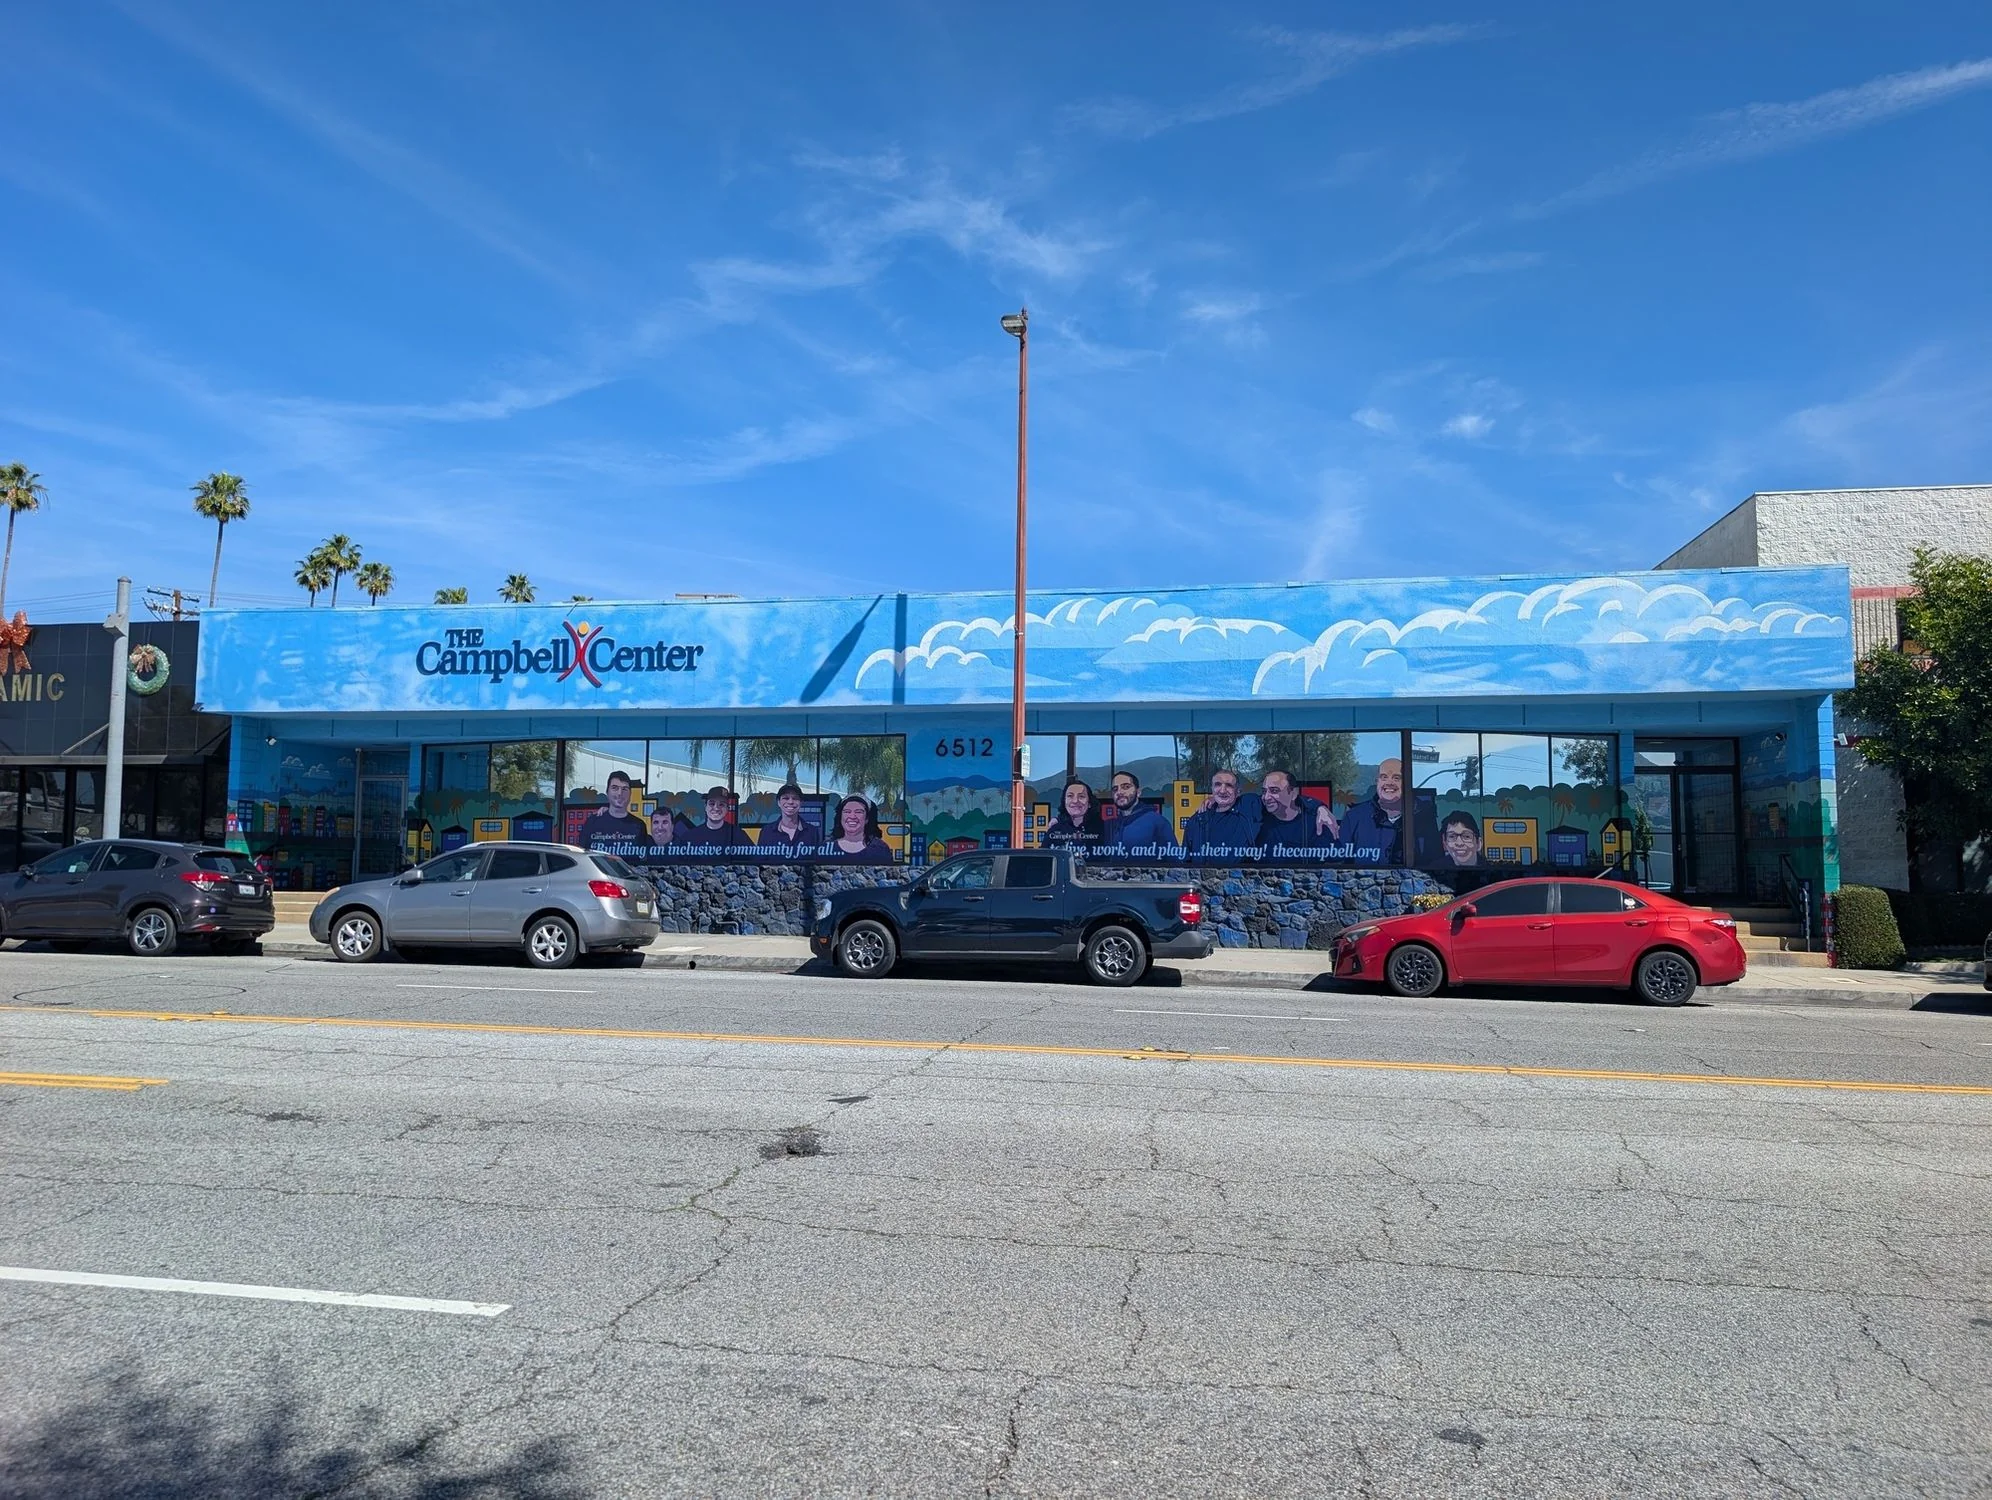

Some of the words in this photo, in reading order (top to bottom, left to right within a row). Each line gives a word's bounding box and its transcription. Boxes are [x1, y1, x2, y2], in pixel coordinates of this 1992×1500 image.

[445, 629, 483, 648] THE
[416, 639, 570, 683] Campbell
[588, 638, 703, 672] Center
[936, 738, 993, 757] 6512
[650, 846, 665, 855] an
[668, 842, 722, 855] inclusive
[725, 842, 793, 858] community
[794, 842, 815, 858] for
[1092, 842, 1128, 858] work,
[1131, 842, 1156, 856] and
[1158, 842, 1187, 859] play
[1234, 844, 1267, 859] way!
[1273, 843, 1380, 860] thecampbell.org
